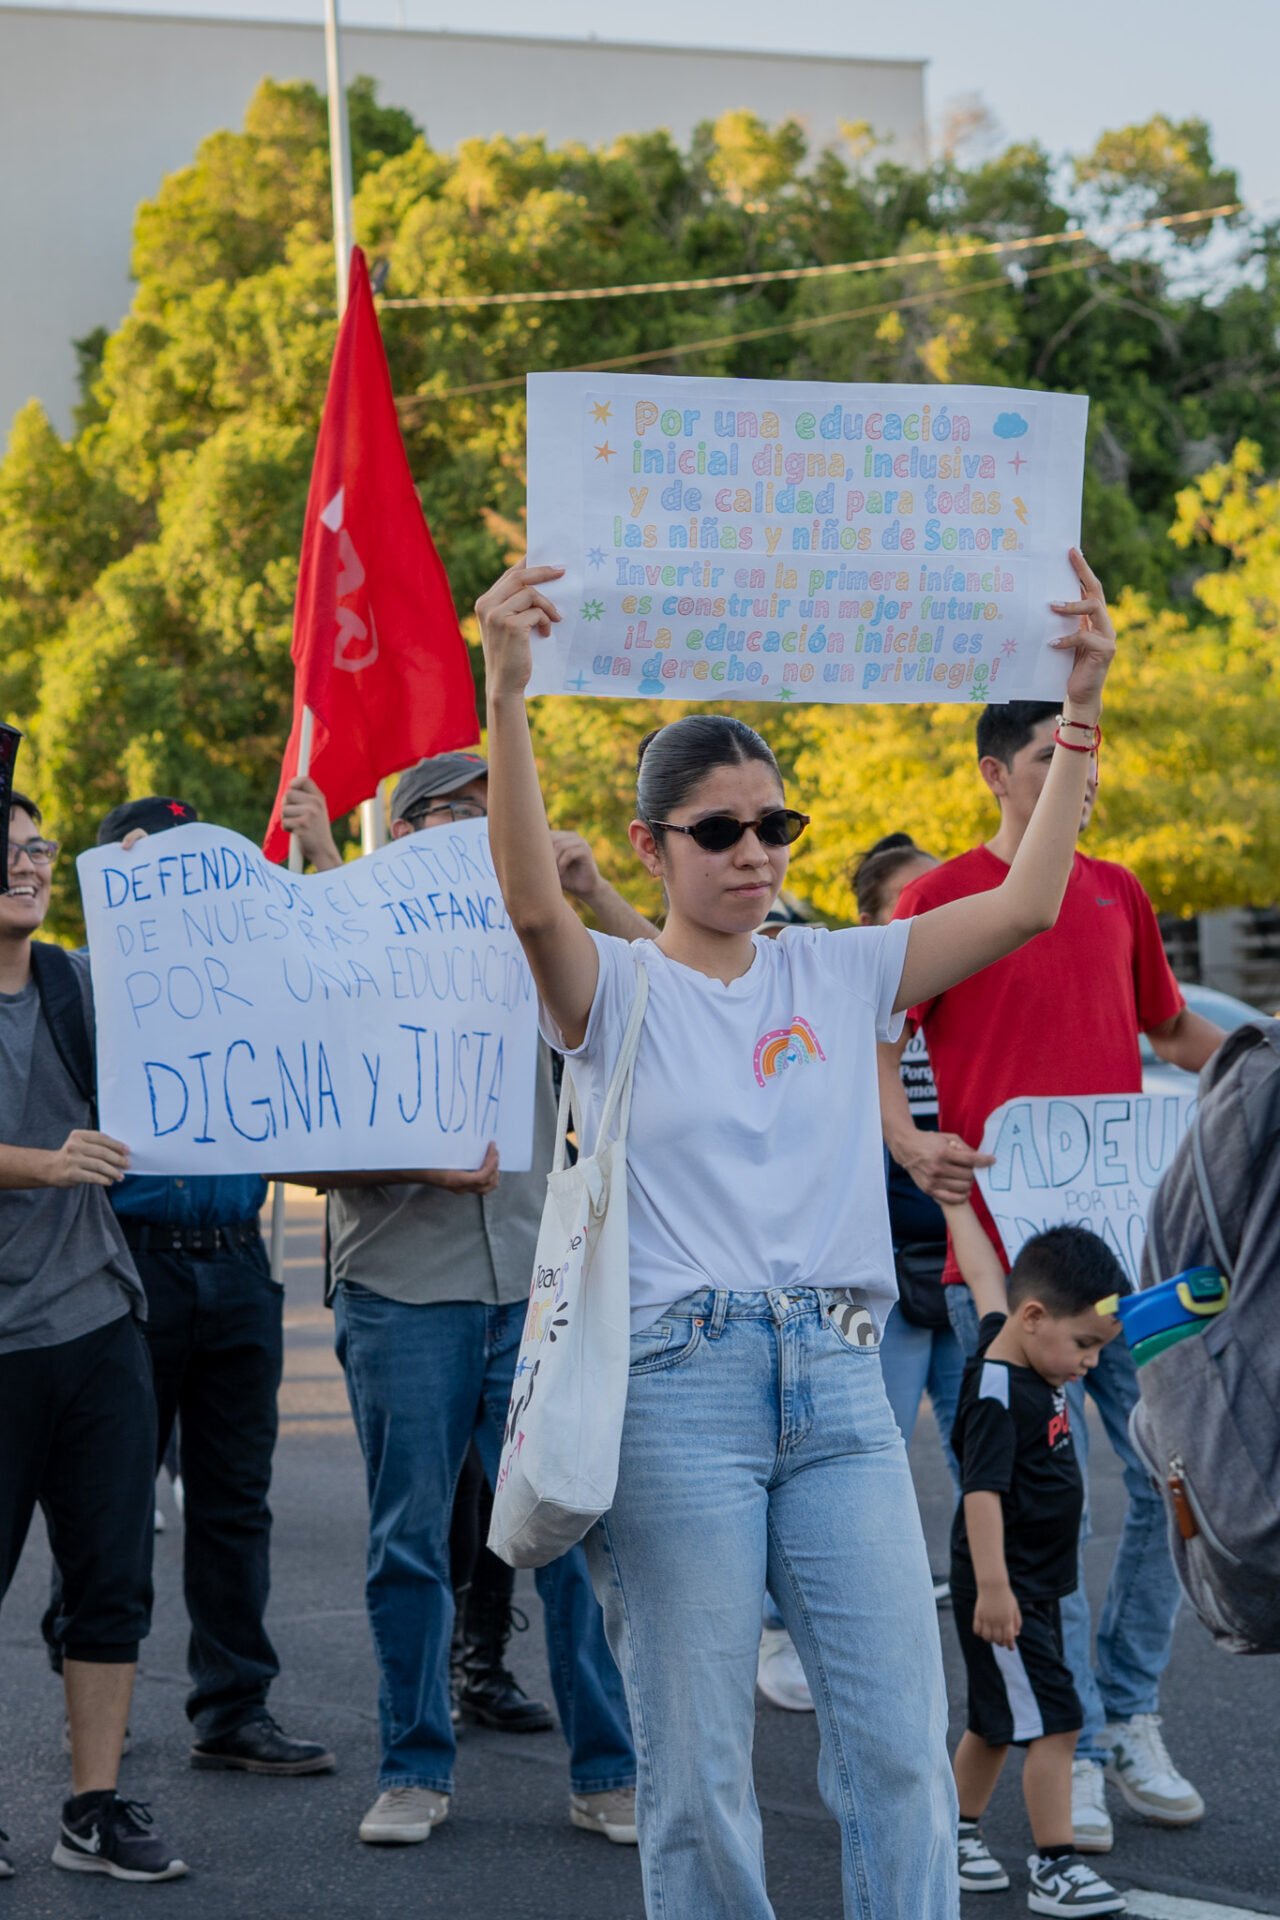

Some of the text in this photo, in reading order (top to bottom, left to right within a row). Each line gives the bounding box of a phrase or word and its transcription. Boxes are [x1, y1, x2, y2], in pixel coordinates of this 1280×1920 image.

[634, 400, 970, 442] Por una educación
[632, 440, 996, 484] inicial digna, inclusiva
[629, 480, 1001, 520] y de calidad para todas
[613, 515, 1024, 556] las niñas y niños de Sonora.
[615, 557, 1015, 597] Invertir en la primera infancia
[621, 593, 1003, 626] es construir un mejor futuro.
[623, 620, 983, 654] ¡La educación inicial es
[592, 652, 1000, 689] un derecho, no un privilegio!
[324, 880, 369, 916] EL
[117, 919, 160, 957] DE
[182, 899, 370, 952] NUESRAS
[124, 956, 254, 1028] POR
[283, 955, 381, 1002] UNA
[144, 1023, 504, 1144] DIGNA Y JUSTA
[988, 1097, 1204, 1191] ADEU
[1065, 1189, 1140, 1212] POR LA
